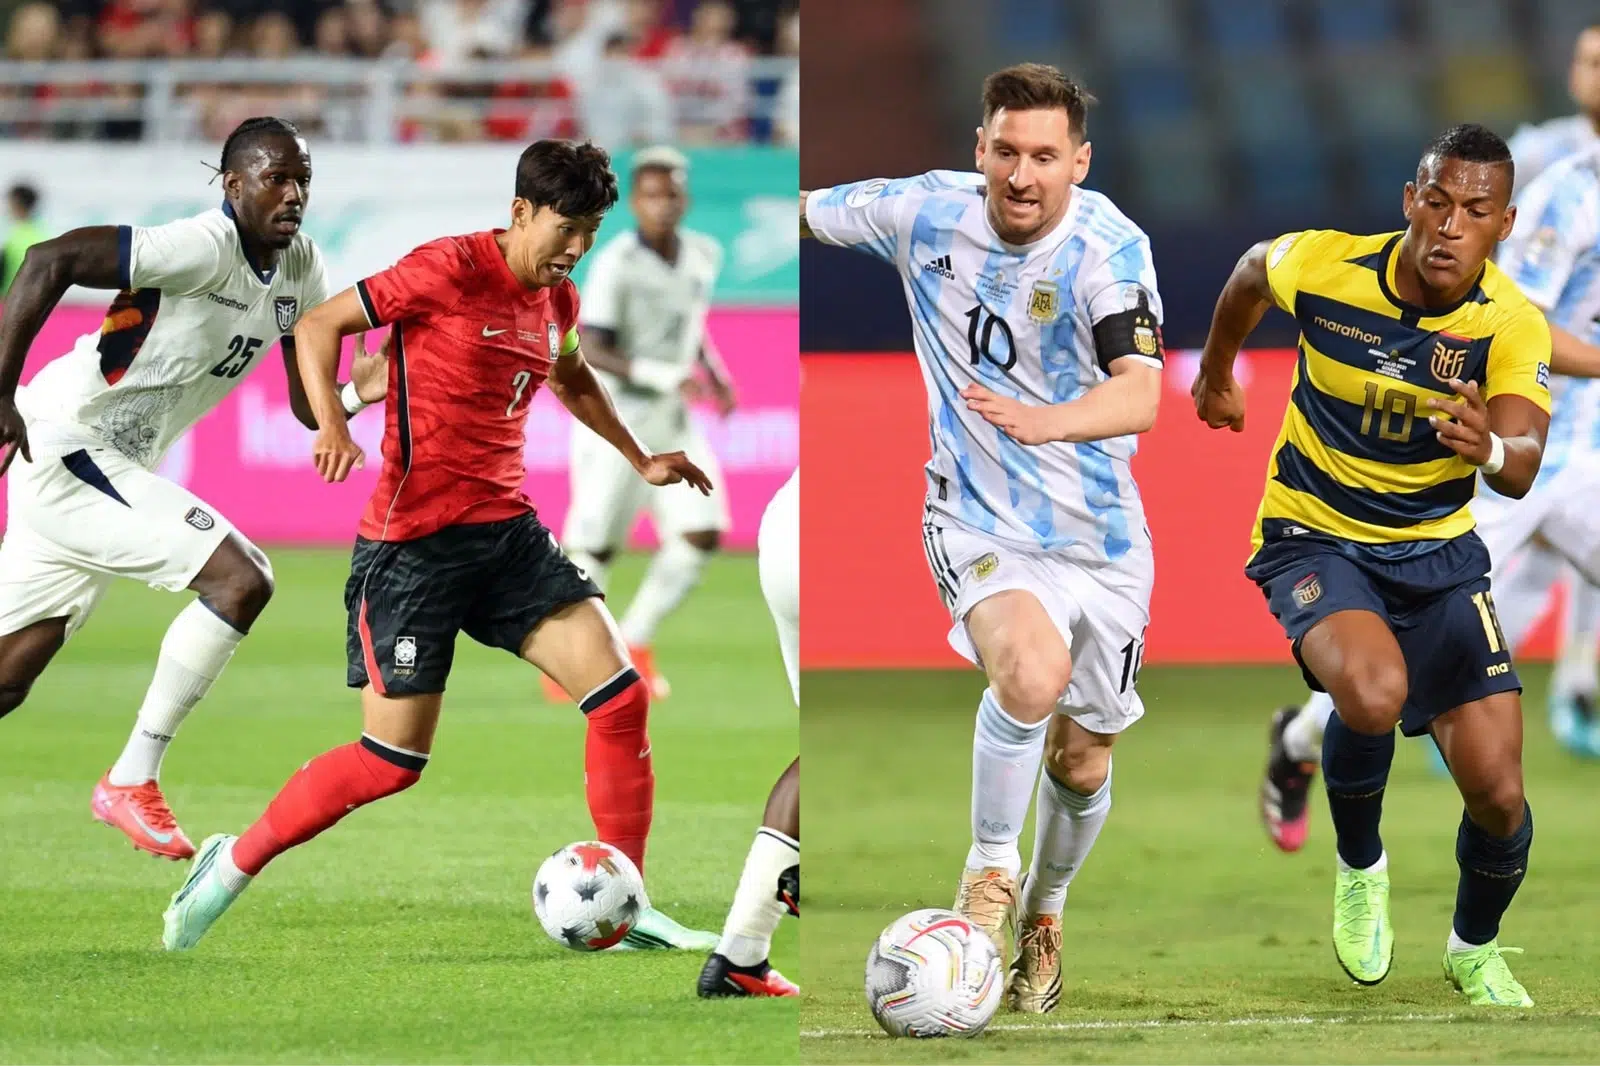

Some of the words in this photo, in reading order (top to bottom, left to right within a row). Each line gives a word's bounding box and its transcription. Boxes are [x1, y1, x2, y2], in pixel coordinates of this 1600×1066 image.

[924, 263, 955, 281] adidas
[207, 292, 249, 312] marathon
[964, 304, 1017, 371] 10
[1313, 315, 1382, 346] marathon
[209, 334, 264, 378] 25
[1360, 380, 1417, 443] 10
[1470, 591, 1508, 653] 1
[1486, 662, 1510, 677] ma
